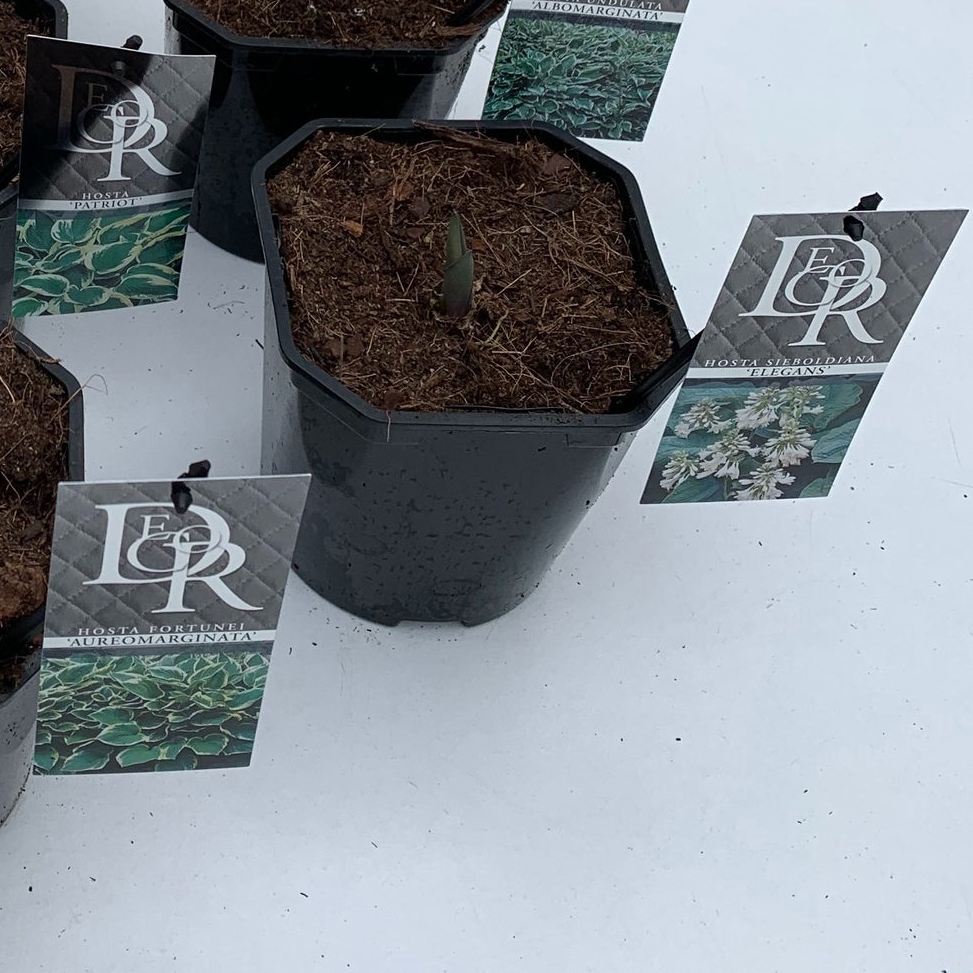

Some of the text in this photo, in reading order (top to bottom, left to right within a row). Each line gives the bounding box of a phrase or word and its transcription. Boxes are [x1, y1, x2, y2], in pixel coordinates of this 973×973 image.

[82, 191, 130, 200] HOSTA
[704, 355, 876, 368] HOSTA SIEBOLDIANA
[77, 622, 245, 636] HOSTA FORTUNEI
